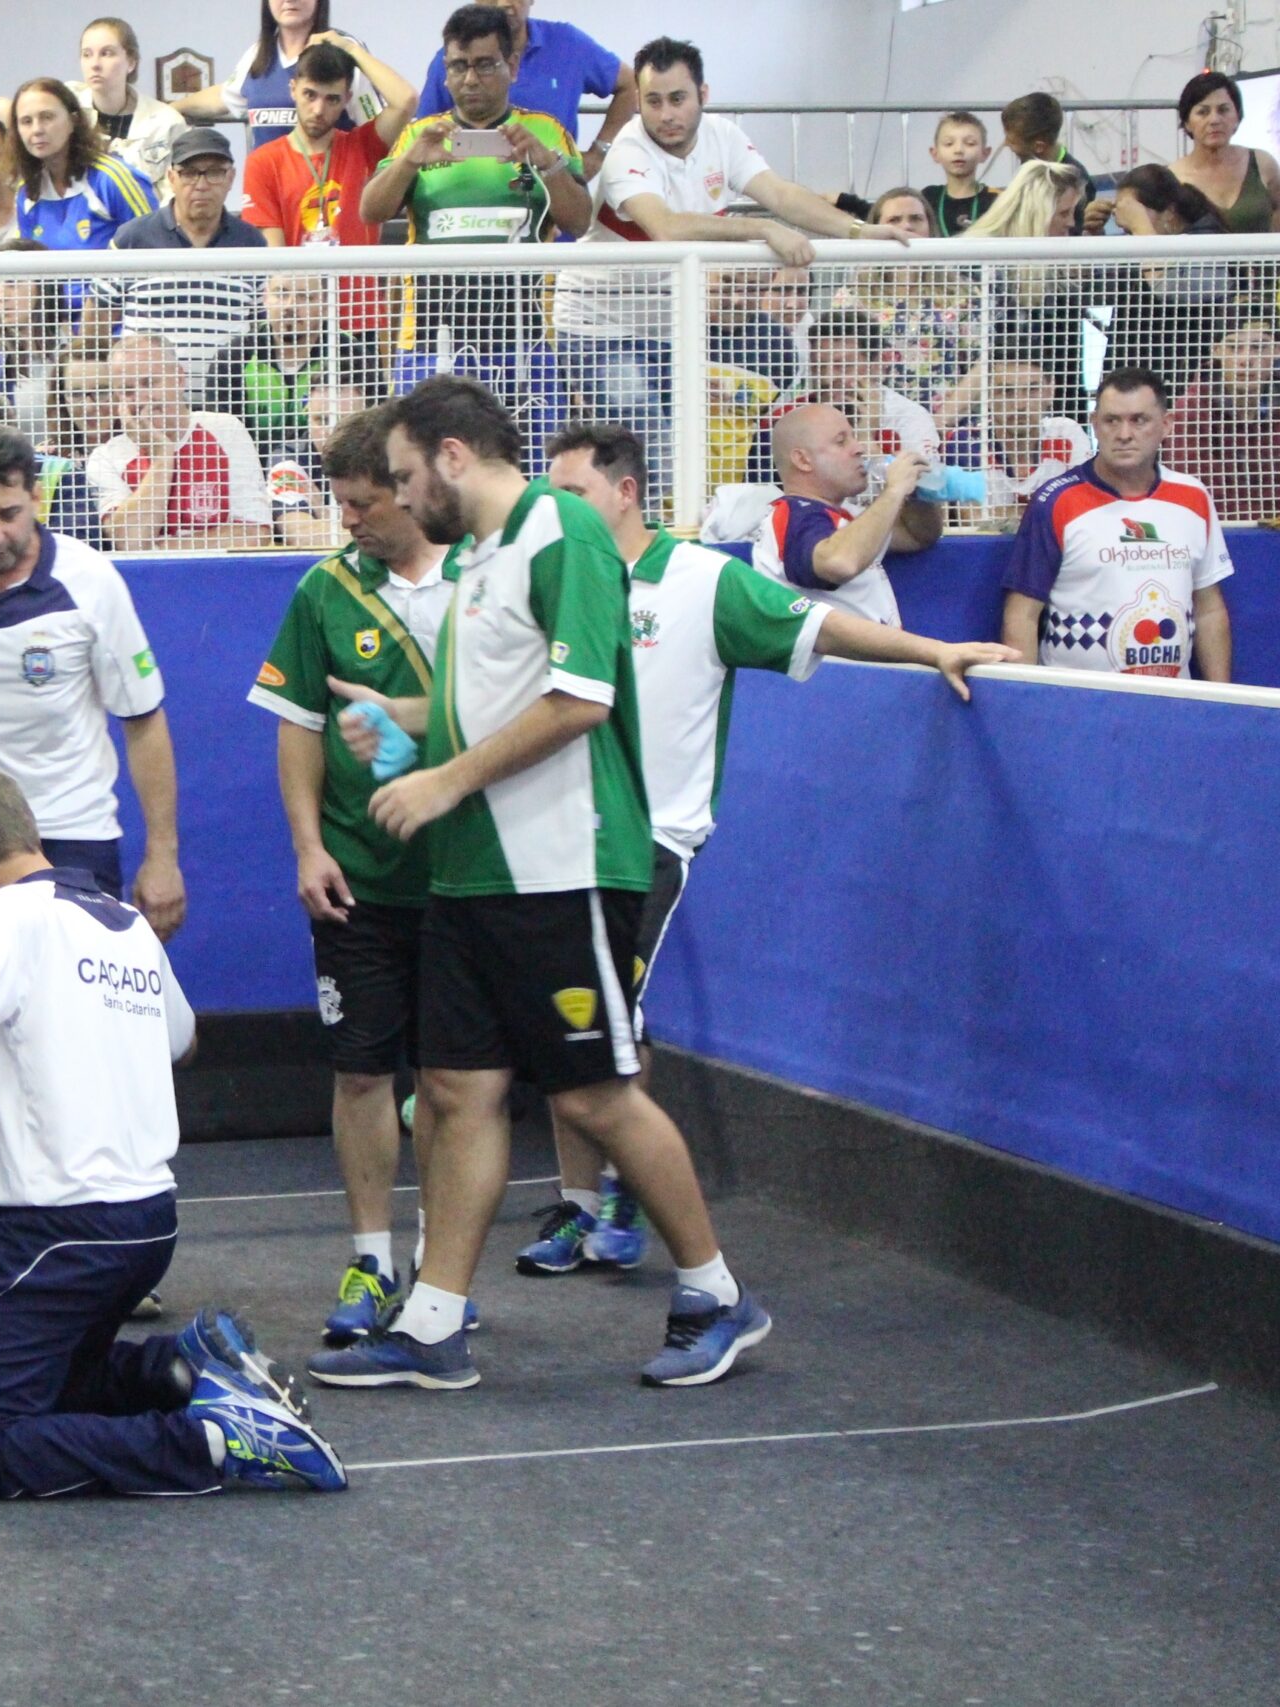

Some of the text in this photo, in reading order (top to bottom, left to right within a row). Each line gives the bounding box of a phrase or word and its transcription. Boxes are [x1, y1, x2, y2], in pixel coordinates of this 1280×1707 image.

[1099, 543, 1191, 570] Oktoberfest
[1125, 645, 1181, 667] BOCHA
[125, 1000, 162, 1018] Catarina
